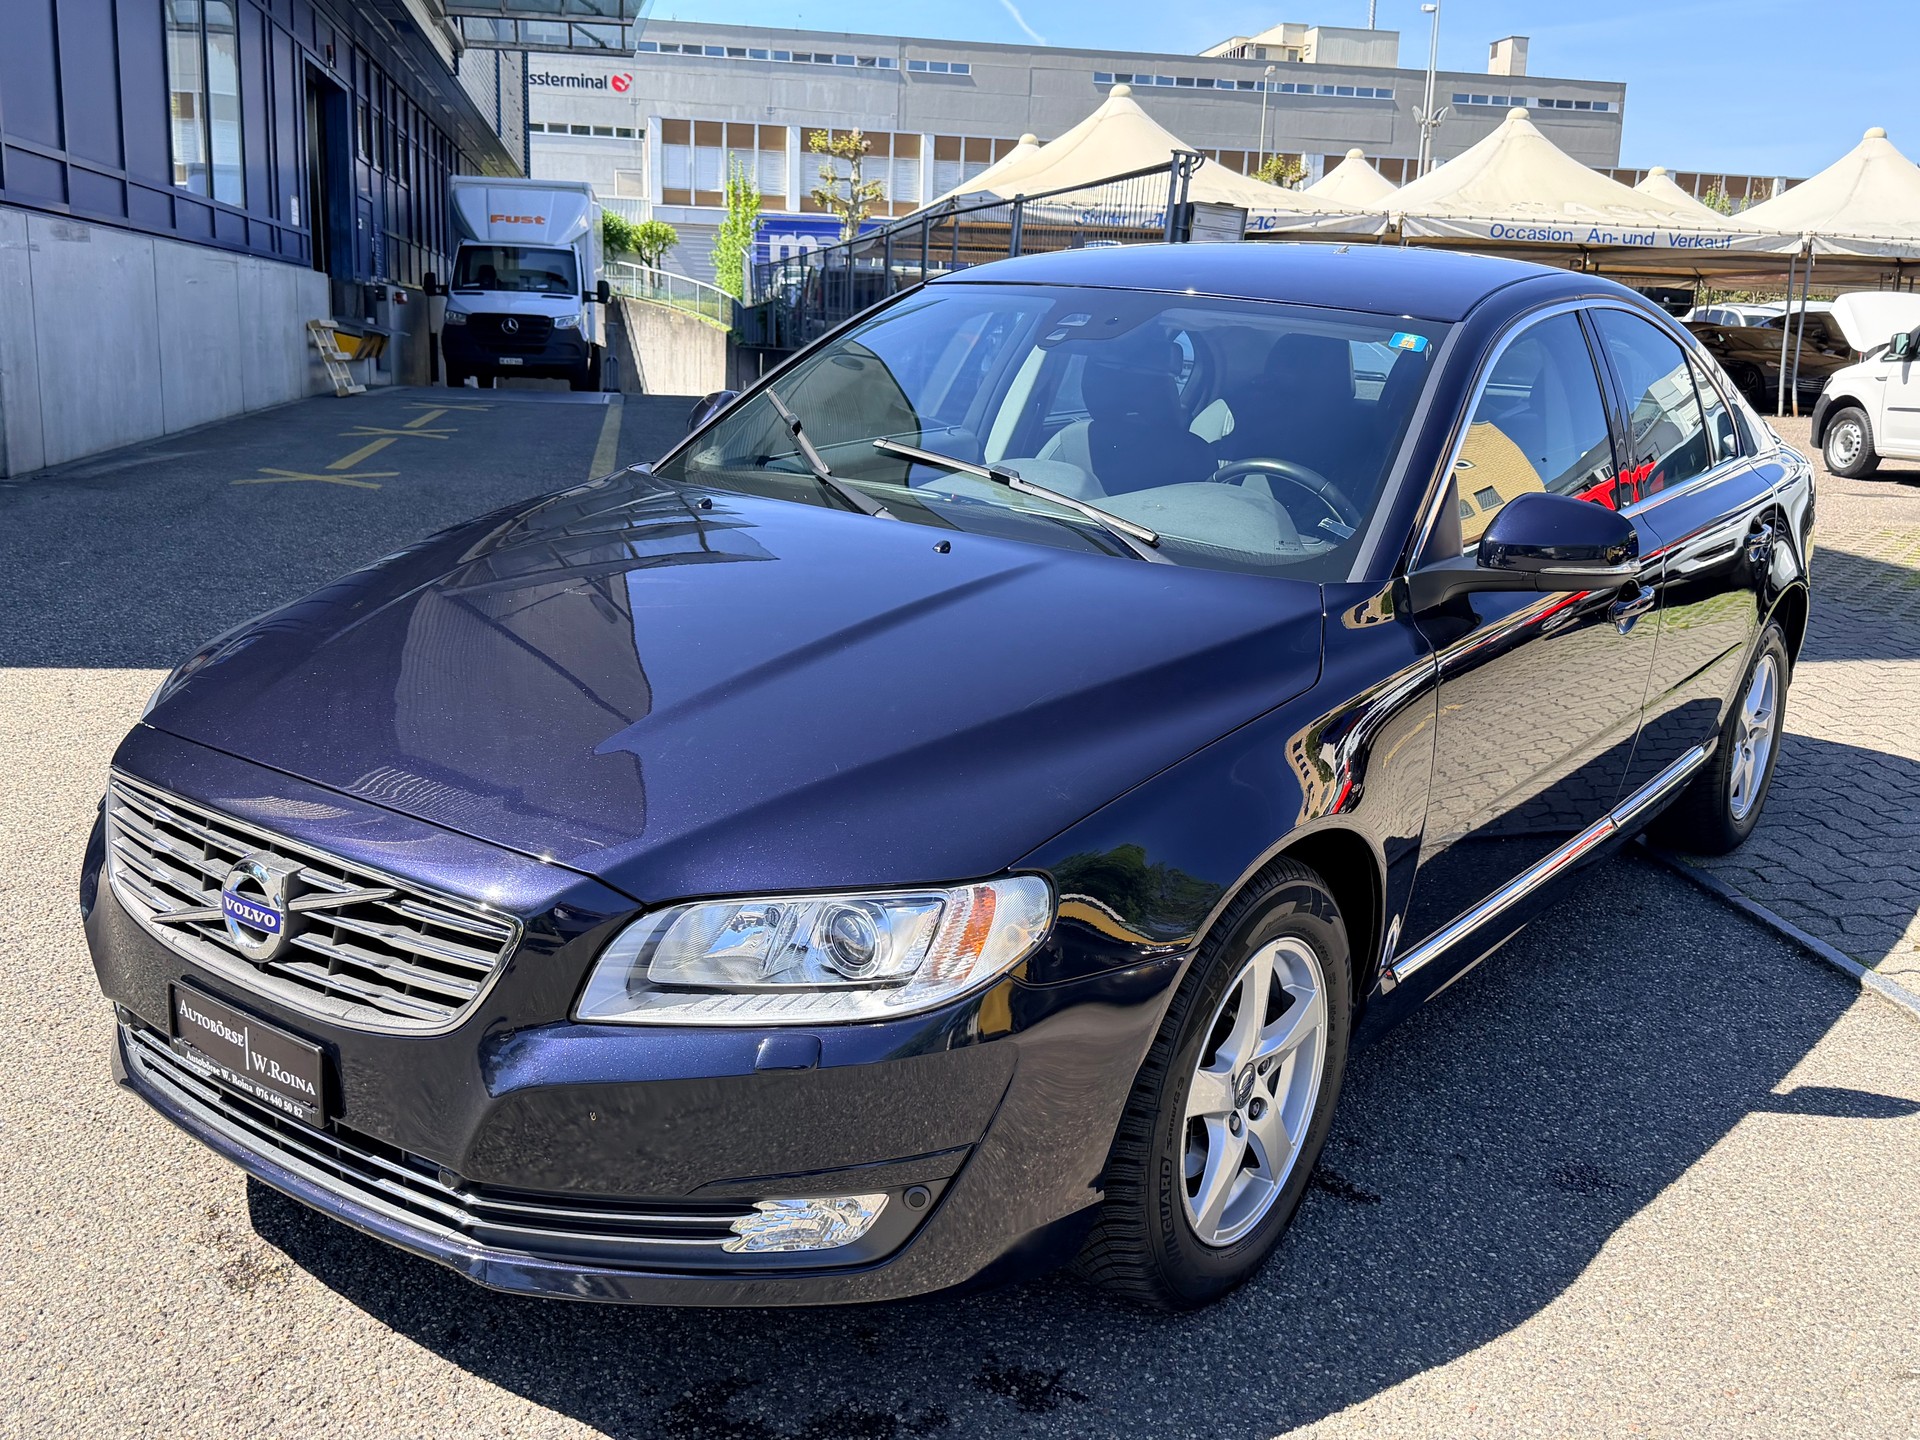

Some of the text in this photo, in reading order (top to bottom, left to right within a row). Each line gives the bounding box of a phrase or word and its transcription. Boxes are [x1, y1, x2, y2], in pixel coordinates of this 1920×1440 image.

[1490, 223, 1574, 242] Occasion
[1668, 232, 1733, 249] Verkauf
[224, 896, 276, 927] VOLVO
[231, 1073, 254, 1093] Roina
[255, 1086, 269, 1101] 076
[283, 1100, 293, 1113] 50
